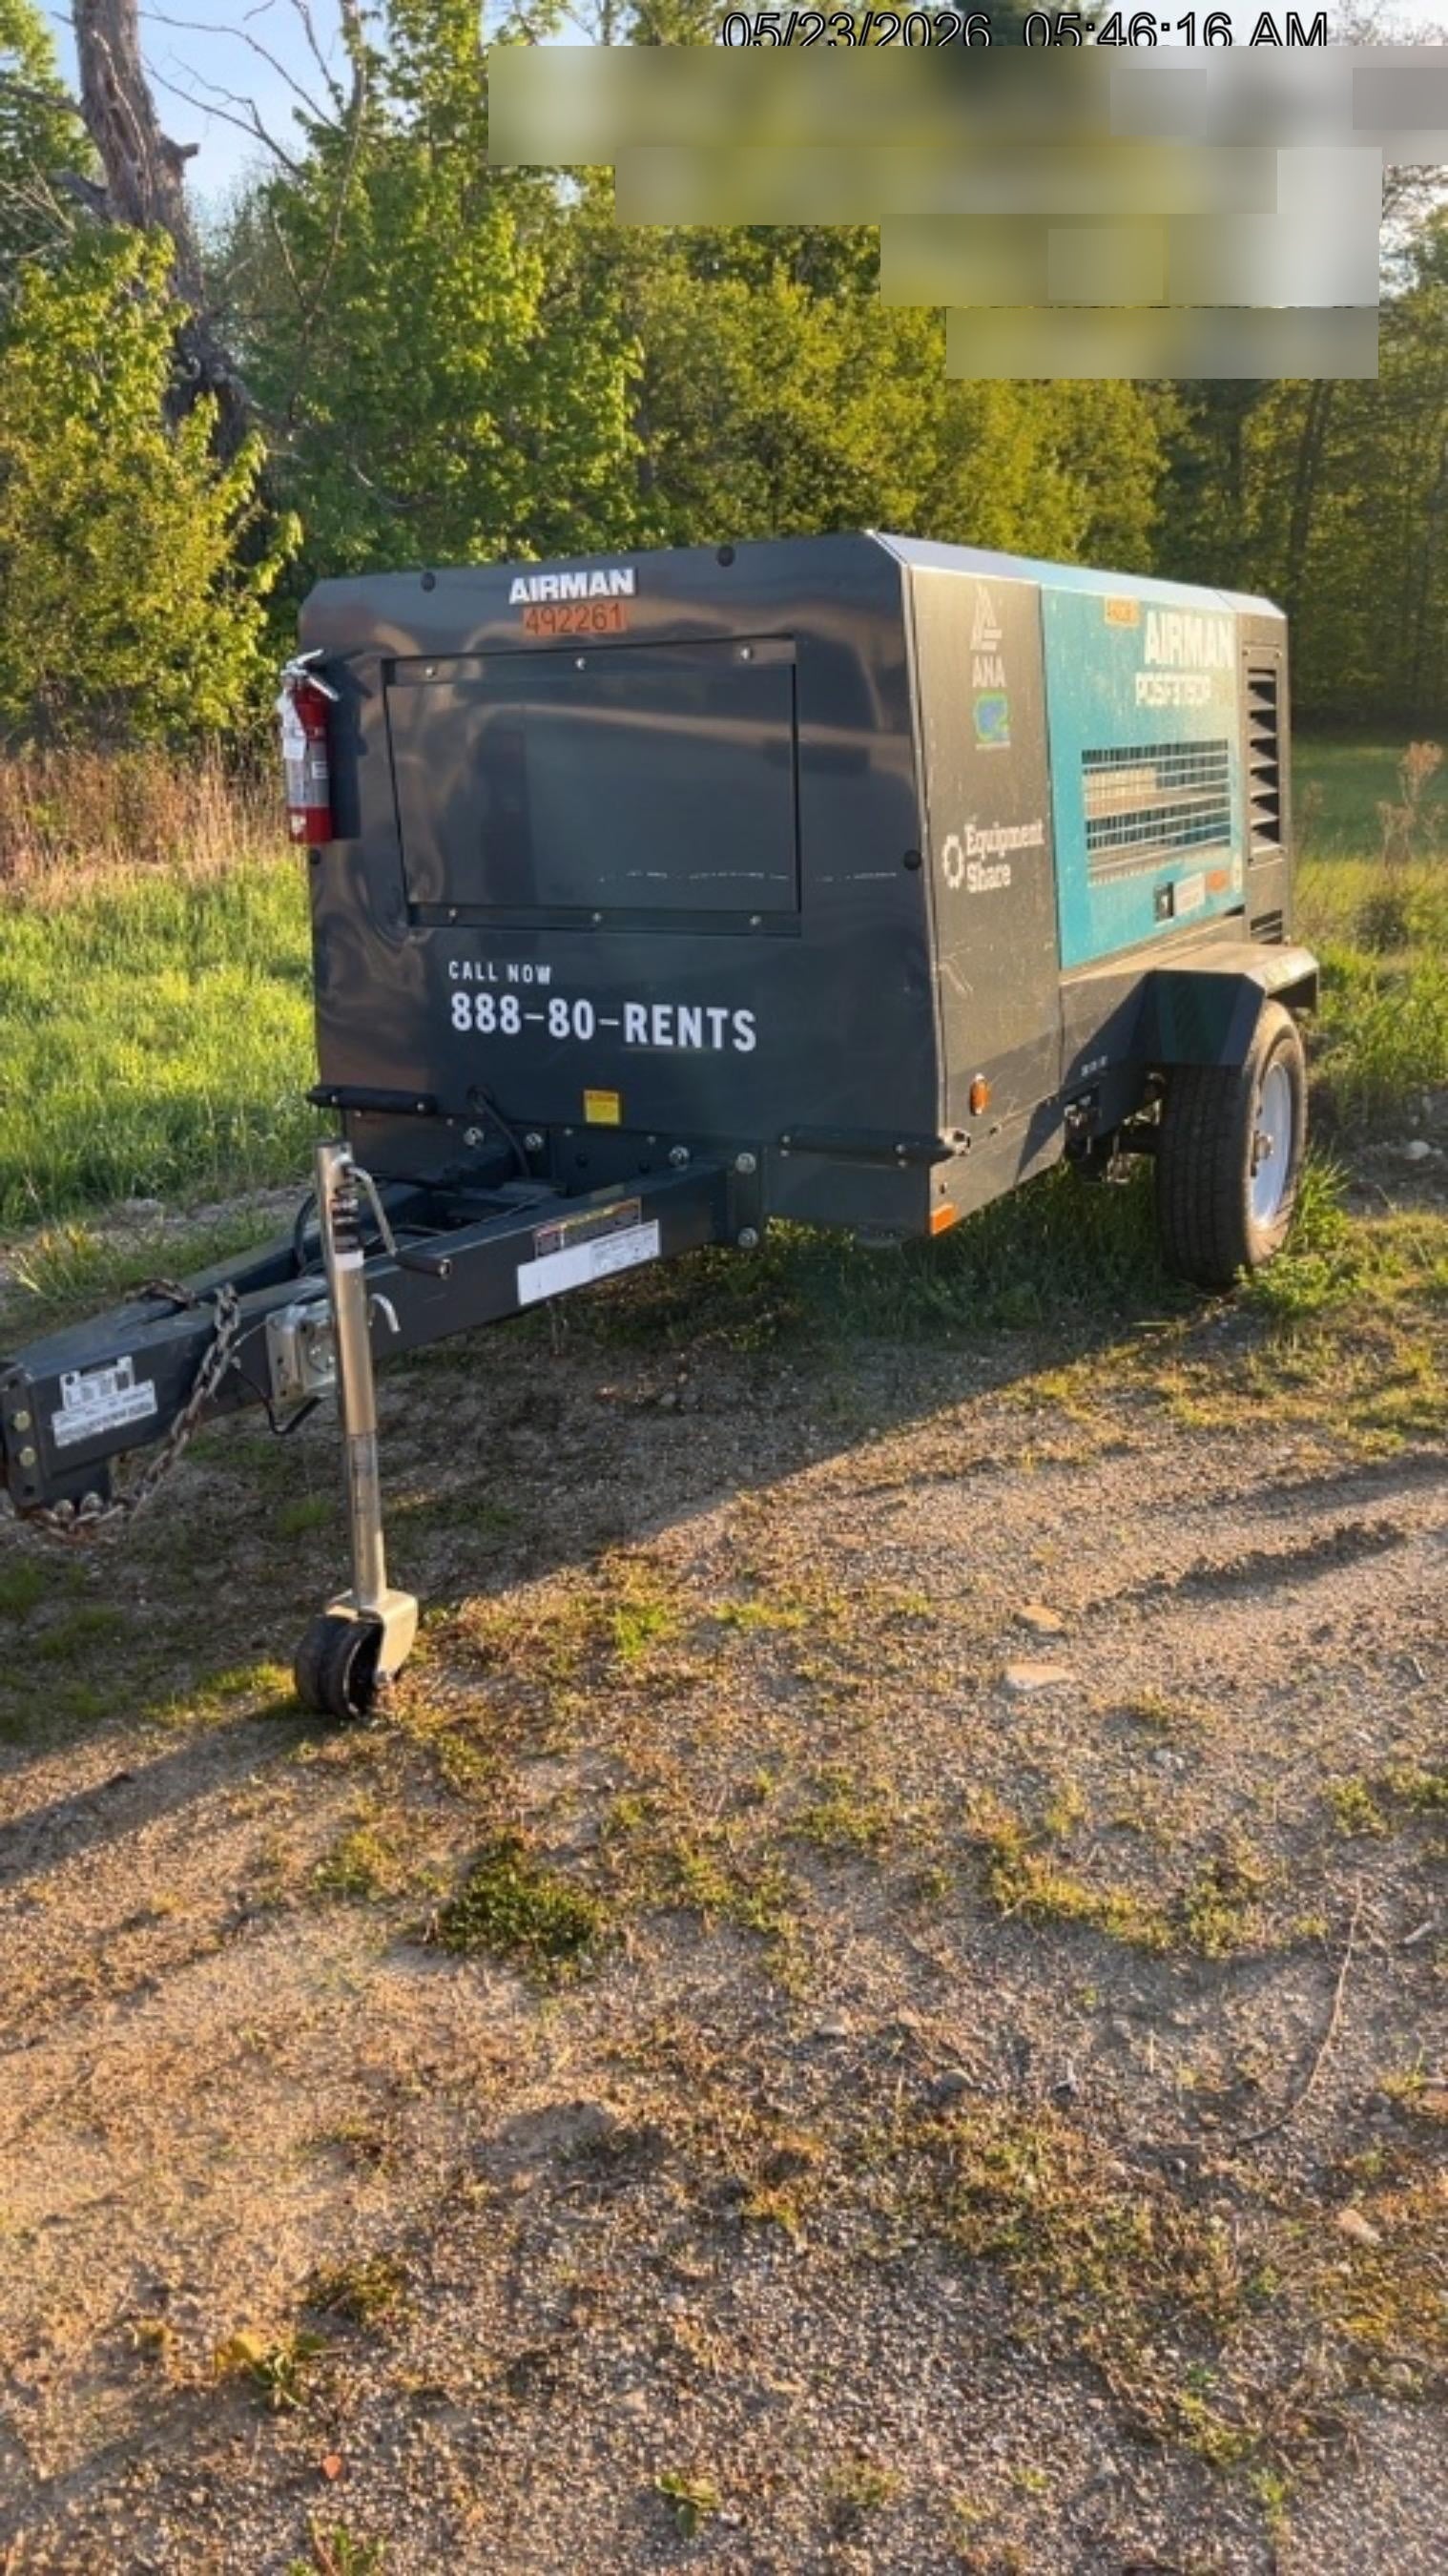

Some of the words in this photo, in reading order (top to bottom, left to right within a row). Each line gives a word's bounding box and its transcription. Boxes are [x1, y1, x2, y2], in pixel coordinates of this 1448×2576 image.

[508, 567, 635, 604] AIRMAN
[526, 603, 620, 634] 492261
[1145, 611, 1236, 668] AIRMAN
[972, 654, 1006, 688] ANA
[964, 819, 1045, 860] Equipment
[966, 862, 1011, 893] Share
[448, 960, 498, 982] CALL
[507, 964, 552, 985] NOW
[450, 991, 757, 1051] 888-80-RENTS
